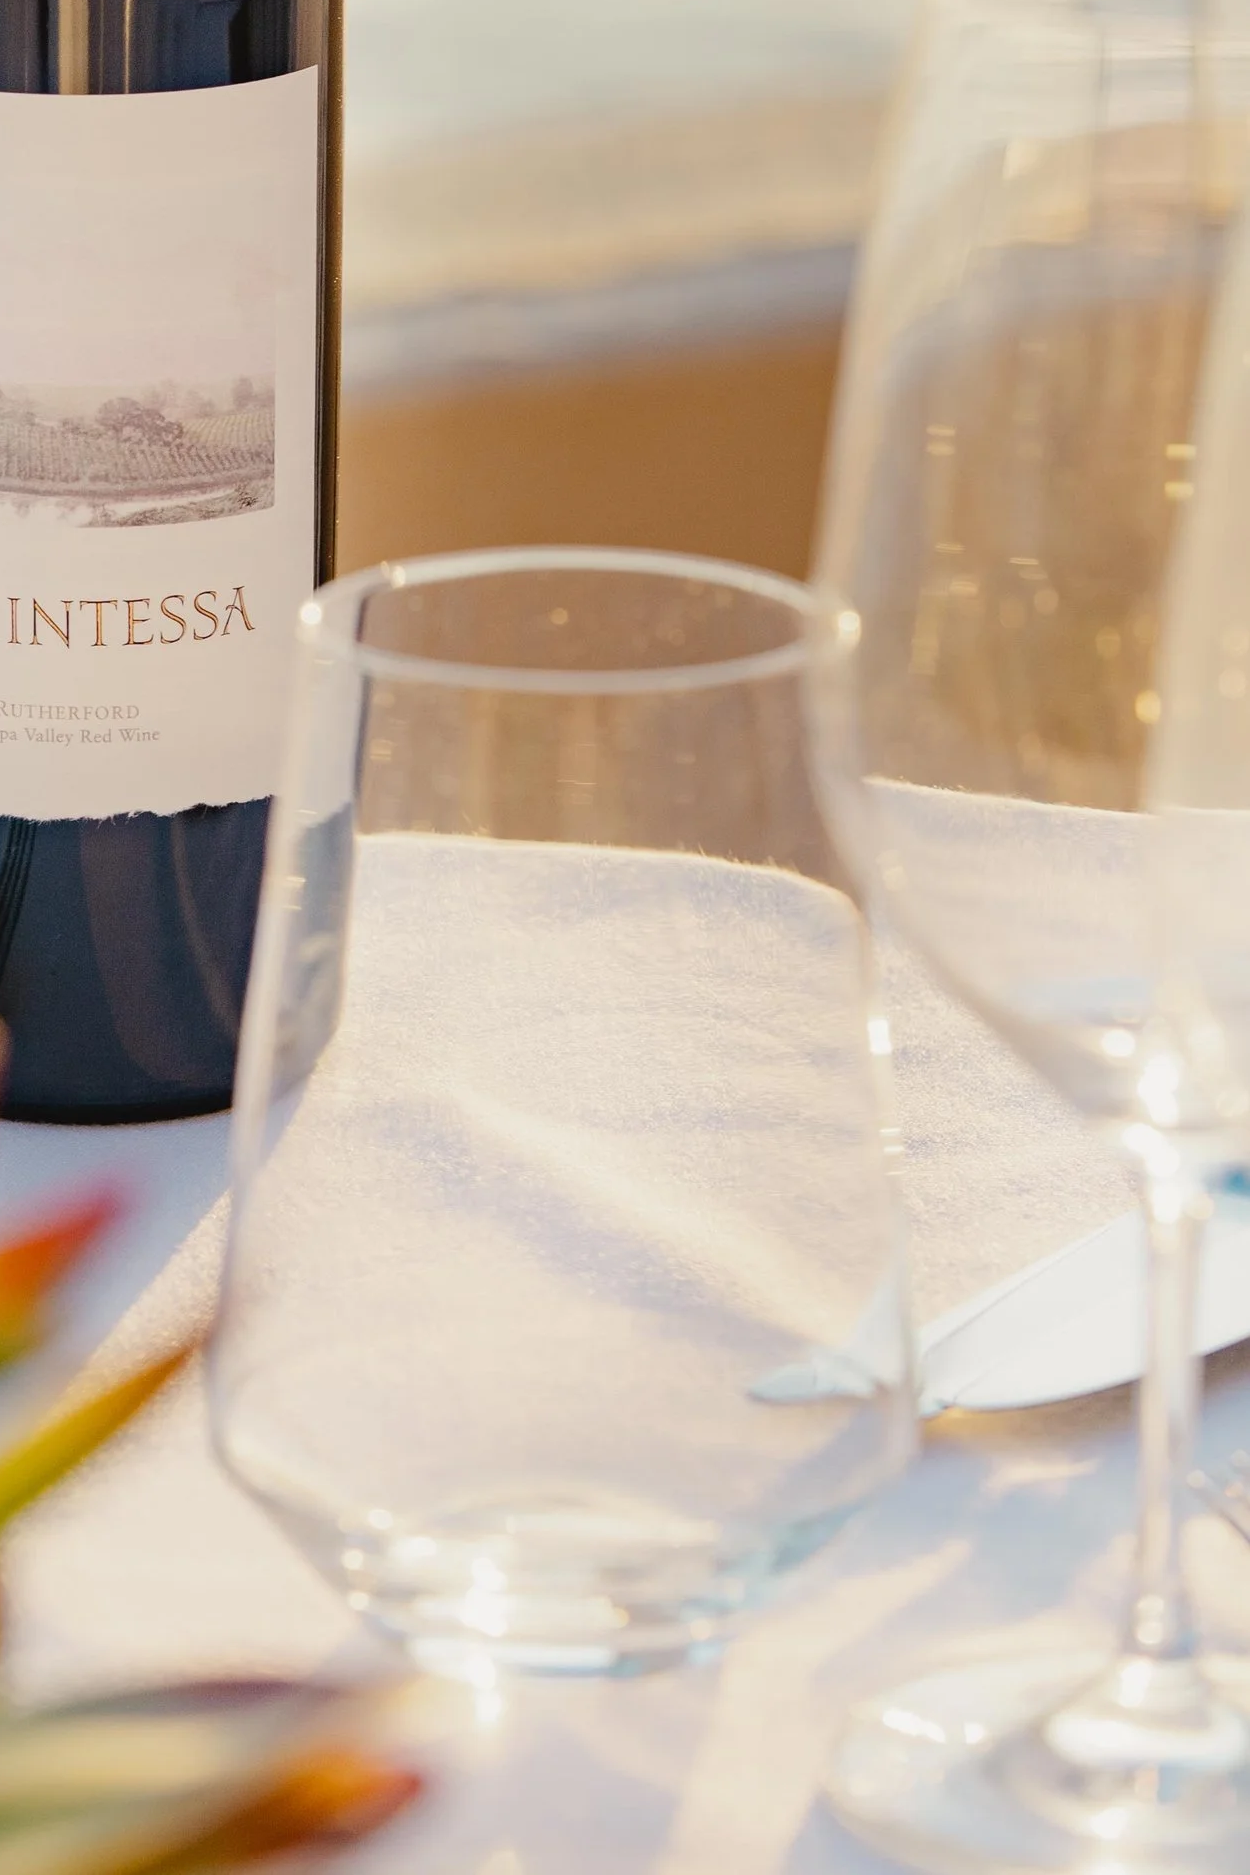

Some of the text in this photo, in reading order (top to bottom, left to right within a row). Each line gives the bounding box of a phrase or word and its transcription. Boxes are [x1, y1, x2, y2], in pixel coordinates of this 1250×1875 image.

[24, 727, 74, 747] Valley
[80, 728, 112, 744] Red
[118, 727, 161, 742] Wine
